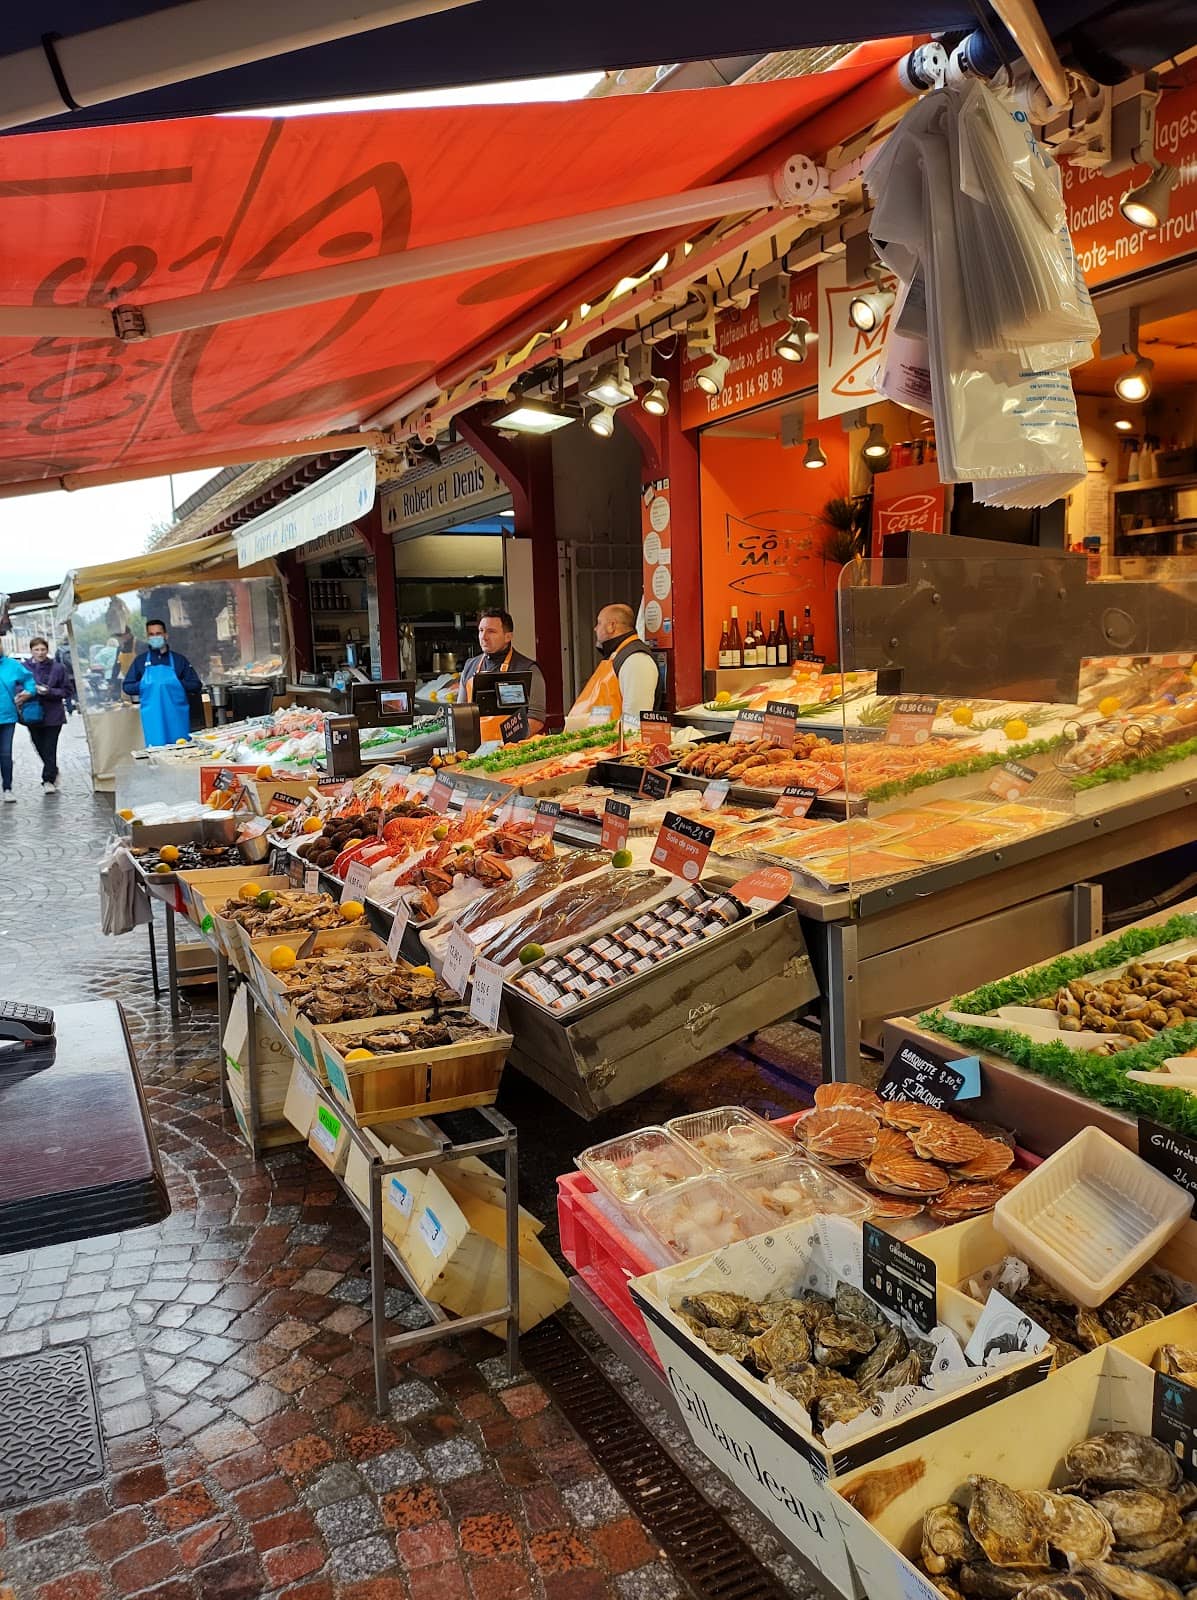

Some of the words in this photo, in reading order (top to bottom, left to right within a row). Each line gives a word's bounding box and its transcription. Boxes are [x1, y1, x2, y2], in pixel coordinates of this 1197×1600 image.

[1154, 110, 1197, 151] lages
[1070, 195, 1114, 233] locales
[722, 385, 733, 407] 02
[735, 382, 745, 403] 31
[746, 379, 756, 398] 14
[757, 371, 769, 392] 98
[771, 366, 783, 389] 98
[403, 483, 434, 519] Robert
[438, 479, 449, 505] et
[453, 459, 485, 499] Denis
[888, 510, 929, 532] Côté
[671, 816, 682, 830] 2
[665, 833, 679, 844] Sole
[686, 843, 700, 855] pays
[900, 1048, 938, 1076] BARQUETTE
[916, 1073, 928, 1083] DE
[911, 1082, 945, 1109] JACQUES
[668, 1365, 829, 1543] Gillardeau
